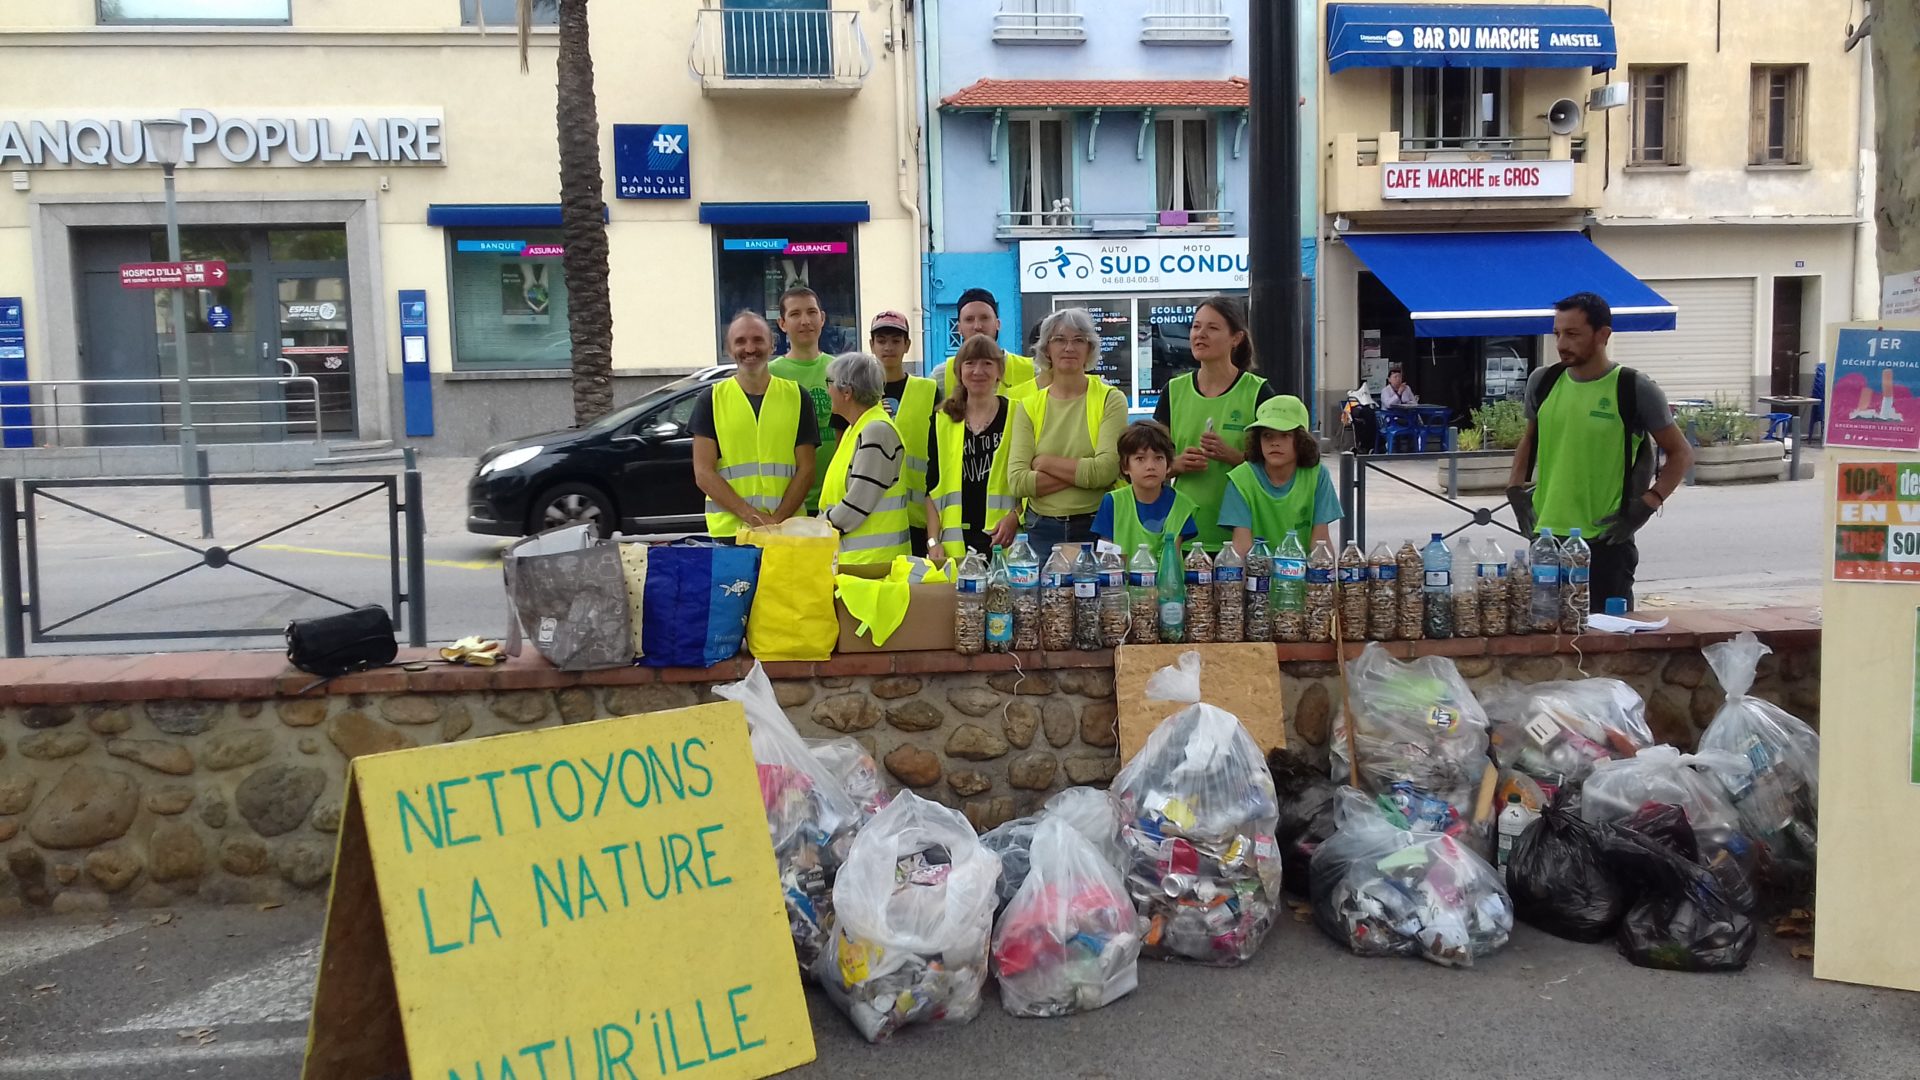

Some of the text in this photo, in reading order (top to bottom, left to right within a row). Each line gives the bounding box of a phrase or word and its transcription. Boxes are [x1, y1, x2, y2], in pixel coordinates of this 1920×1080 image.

[1413, 26, 1445, 50] BAR
[1449, 26, 1470, 49] DU
[1475, 27, 1540, 50] MARCHE
[1550, 33, 1601, 47] AMSTEL
[0, 108, 442, 165] ANQU POPULAIRE
[621, 175, 685, 184] BANQUE
[1386, 167, 1540, 188] CAFE MARCHE DE GROS
[622, 186, 685, 194] POPULAIRE
[480, 242, 515, 250] BANQUE
[529, 247, 564, 255] ASSURAN
[745, 241, 778, 249] BANQUE
[791, 244, 832, 252] ASSURANCE
[1100, 254, 1250, 274] SUD CONDU
[122, 268, 182, 277] HOSPICI D'ILLA
[289, 305, 319, 313] ESPACE
[1151, 306, 1183, 314] ECOLE
[1867, 337, 1902, 357] 1ER
[1842, 358, 1919, 368] DÉCHET MONDIAL
[979, 435, 990, 451] TO
[1844, 468, 1893, 495] 100%
[1842, 503, 1888, 522] EN
[396, 737, 713, 854] NETTOYONS
[418, 823, 732, 955] LA NATURE
[448, 984, 766, 1080] TUR'iLLE
